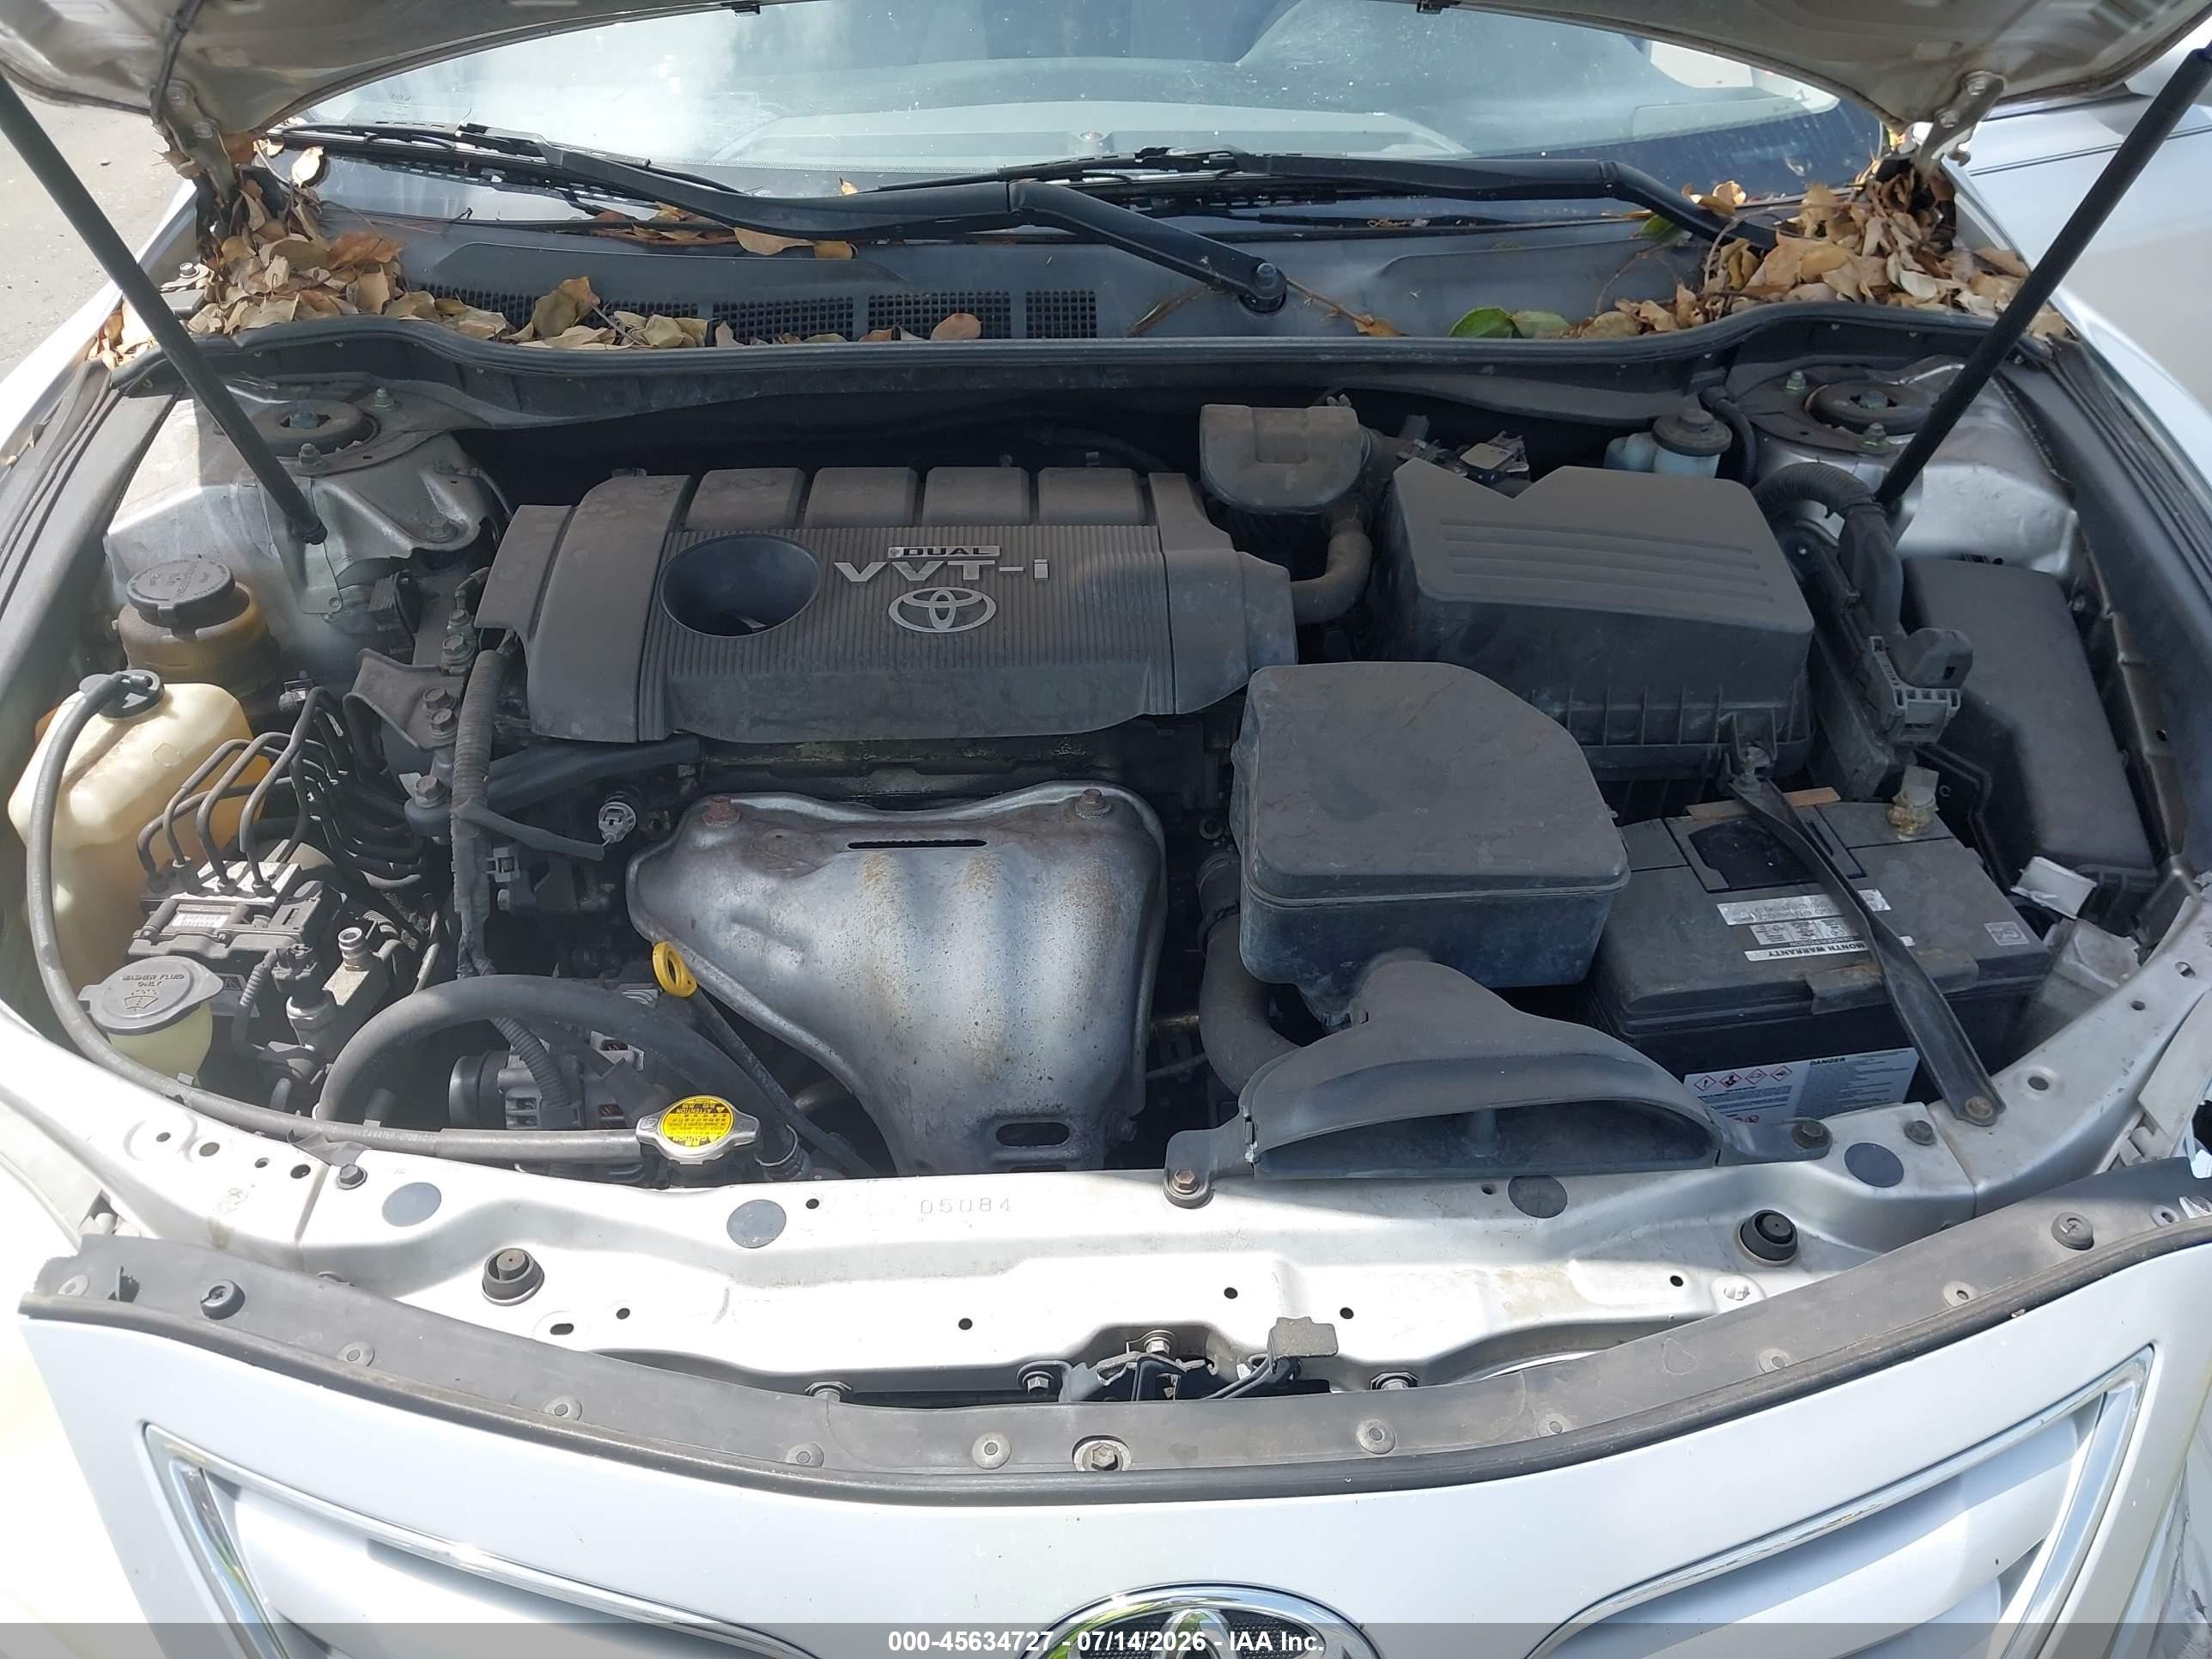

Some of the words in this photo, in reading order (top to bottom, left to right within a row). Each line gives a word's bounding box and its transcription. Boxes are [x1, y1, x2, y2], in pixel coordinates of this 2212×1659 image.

[902, 546, 990, 556] DUAL
[834, 559, 1049, 582] VVT-i
[1767, 945, 1826, 957] WARRANTY
[1826, 941, 1865, 953] MONTH
[1809, 1057, 1846, 1066] DANGER
[920, 1197, 1011, 1214] 05084
